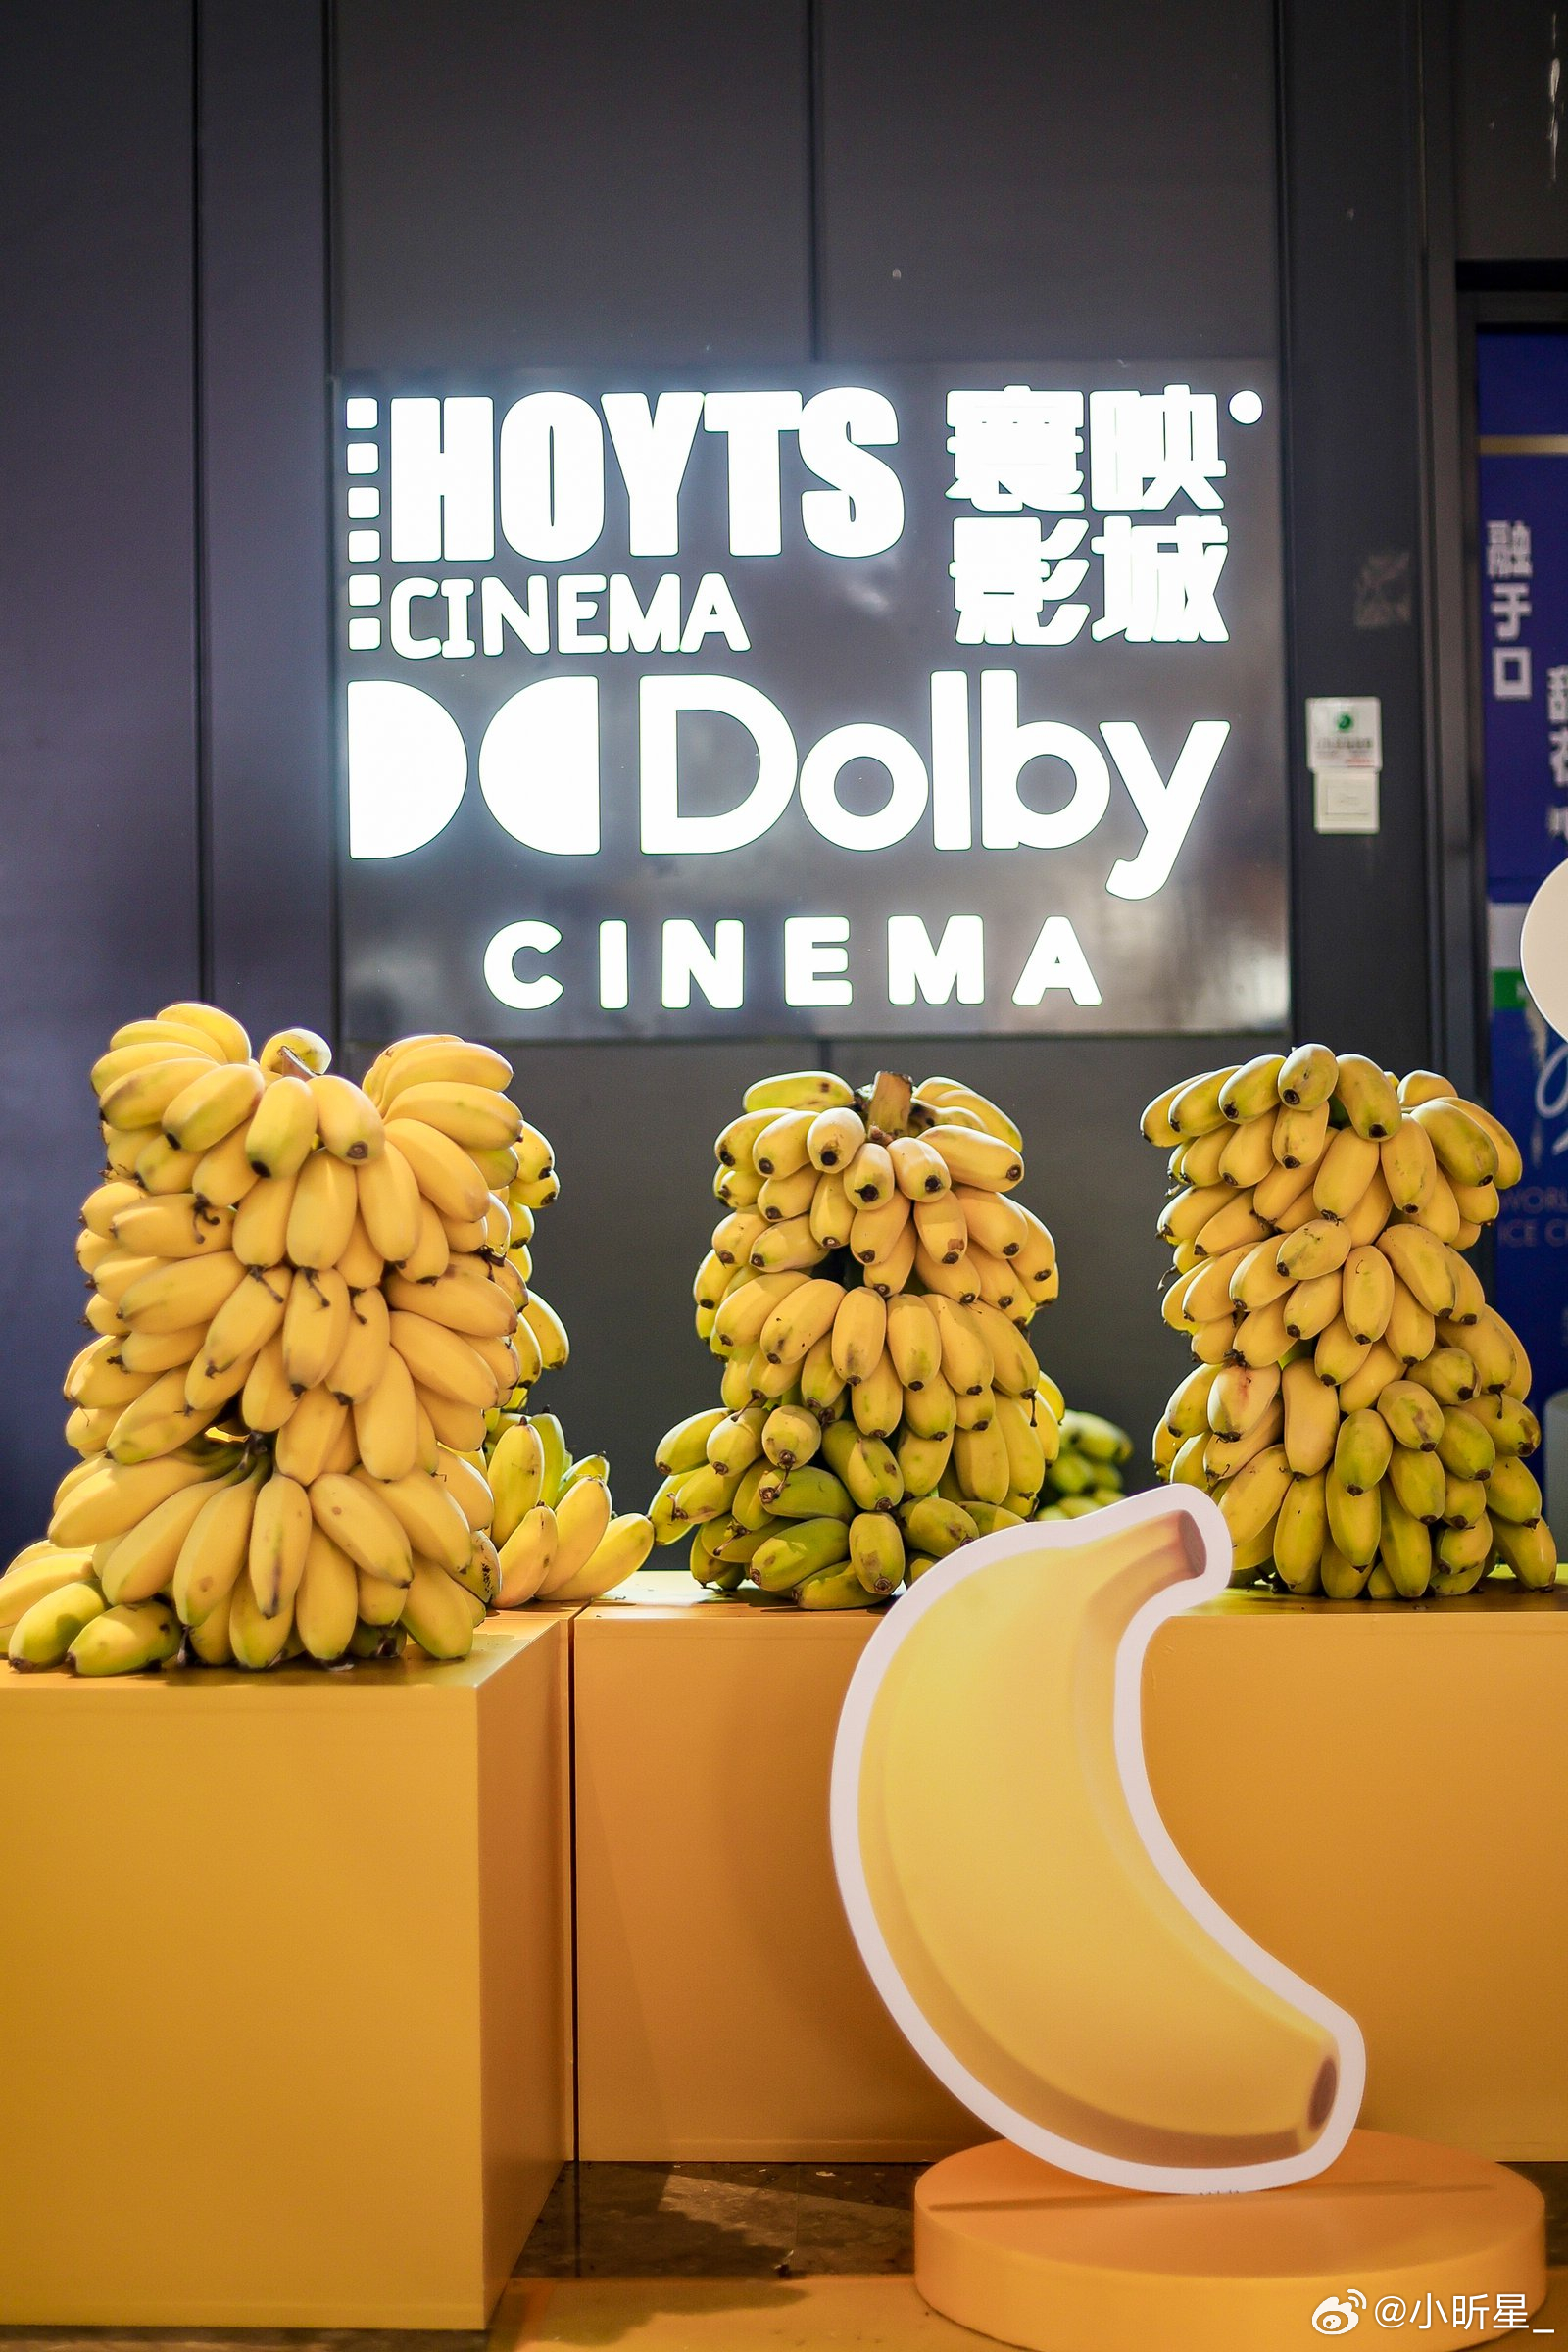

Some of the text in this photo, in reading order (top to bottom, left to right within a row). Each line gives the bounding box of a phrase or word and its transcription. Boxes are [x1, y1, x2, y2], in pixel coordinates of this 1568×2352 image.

[390, 387, 905, 563] HOYTS
[945, 384, 1227, 512] 寰映
[390, 573, 751, 660] CINEMA
[949, 515, 1230, 646] 影城
[639, 669, 1231, 901] Dolby
[483, 914, 1102, 1009] CINEMA
